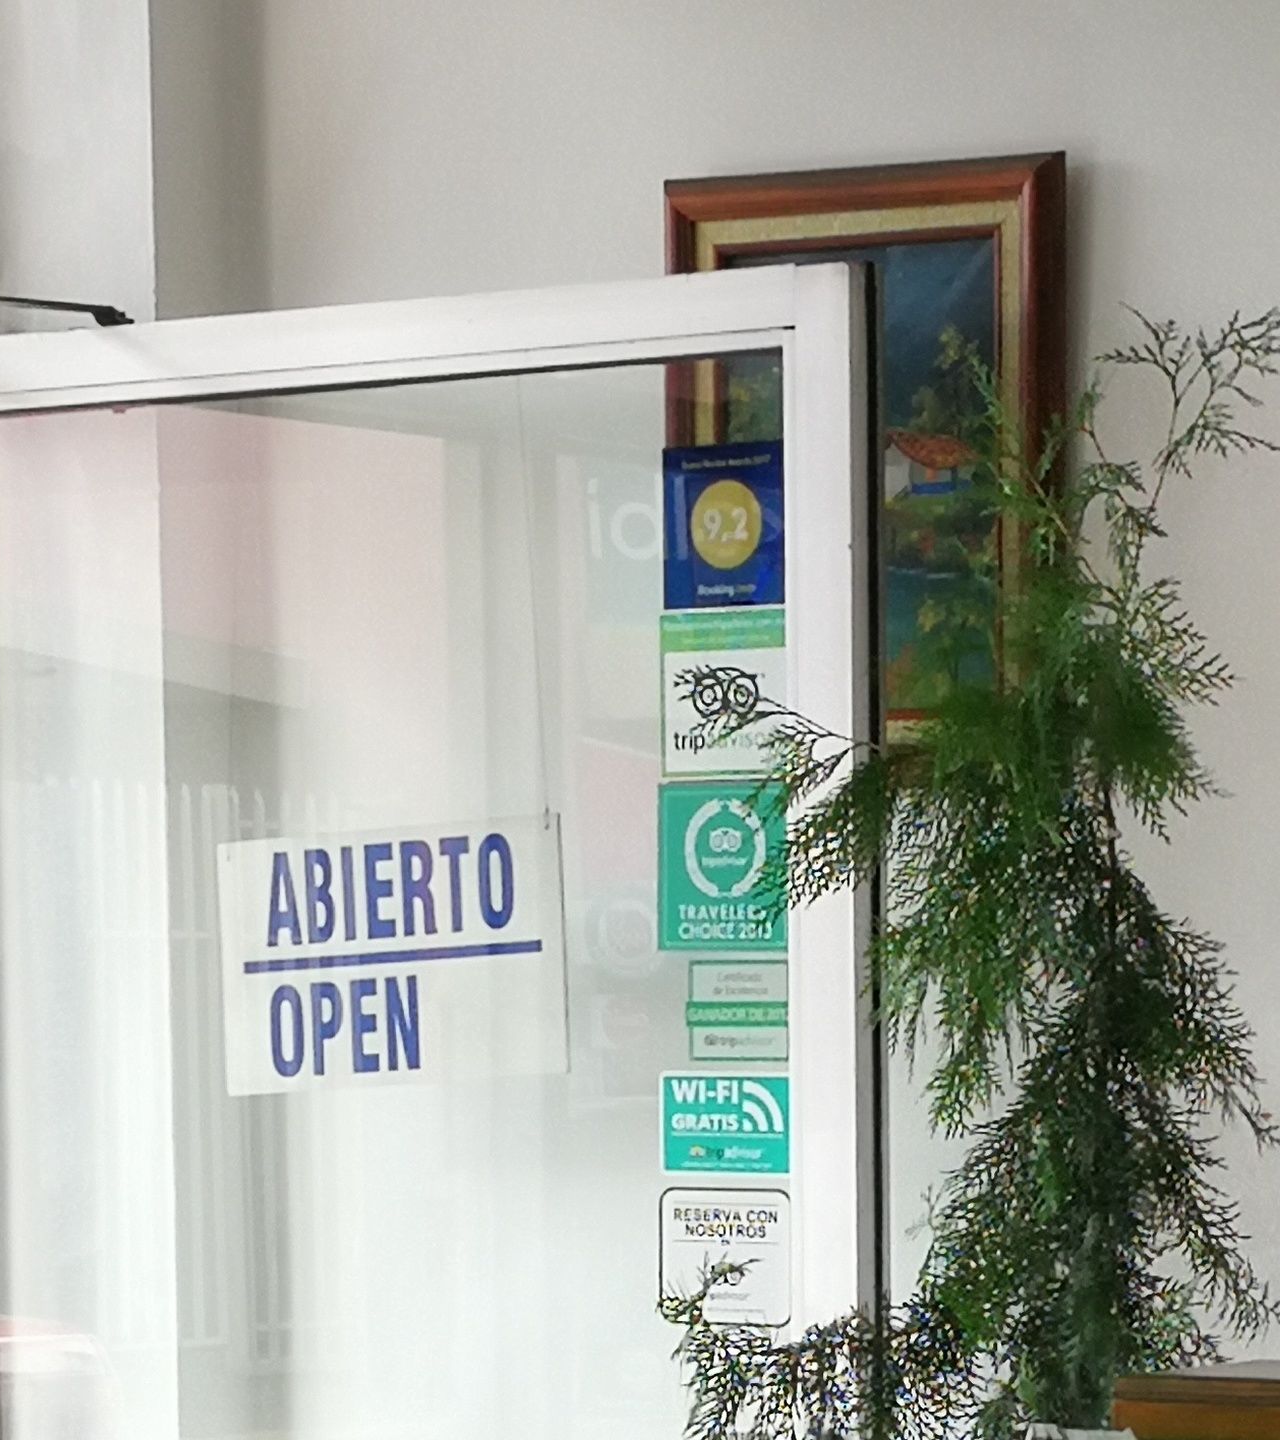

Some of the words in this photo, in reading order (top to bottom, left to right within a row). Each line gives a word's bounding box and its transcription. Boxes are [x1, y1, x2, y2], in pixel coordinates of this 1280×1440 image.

[267, 832, 514, 947] ABIERTO
[270, 974, 421, 1078] OPEN
[671, 1079, 739, 1105] WI-FI
[671, 1113, 739, 1132] GRATIS
[674, 1208, 742, 1223] RESERVA
[746, 1210, 778, 1224] CON
[685, 1223, 766, 1239] NOSOTROS
